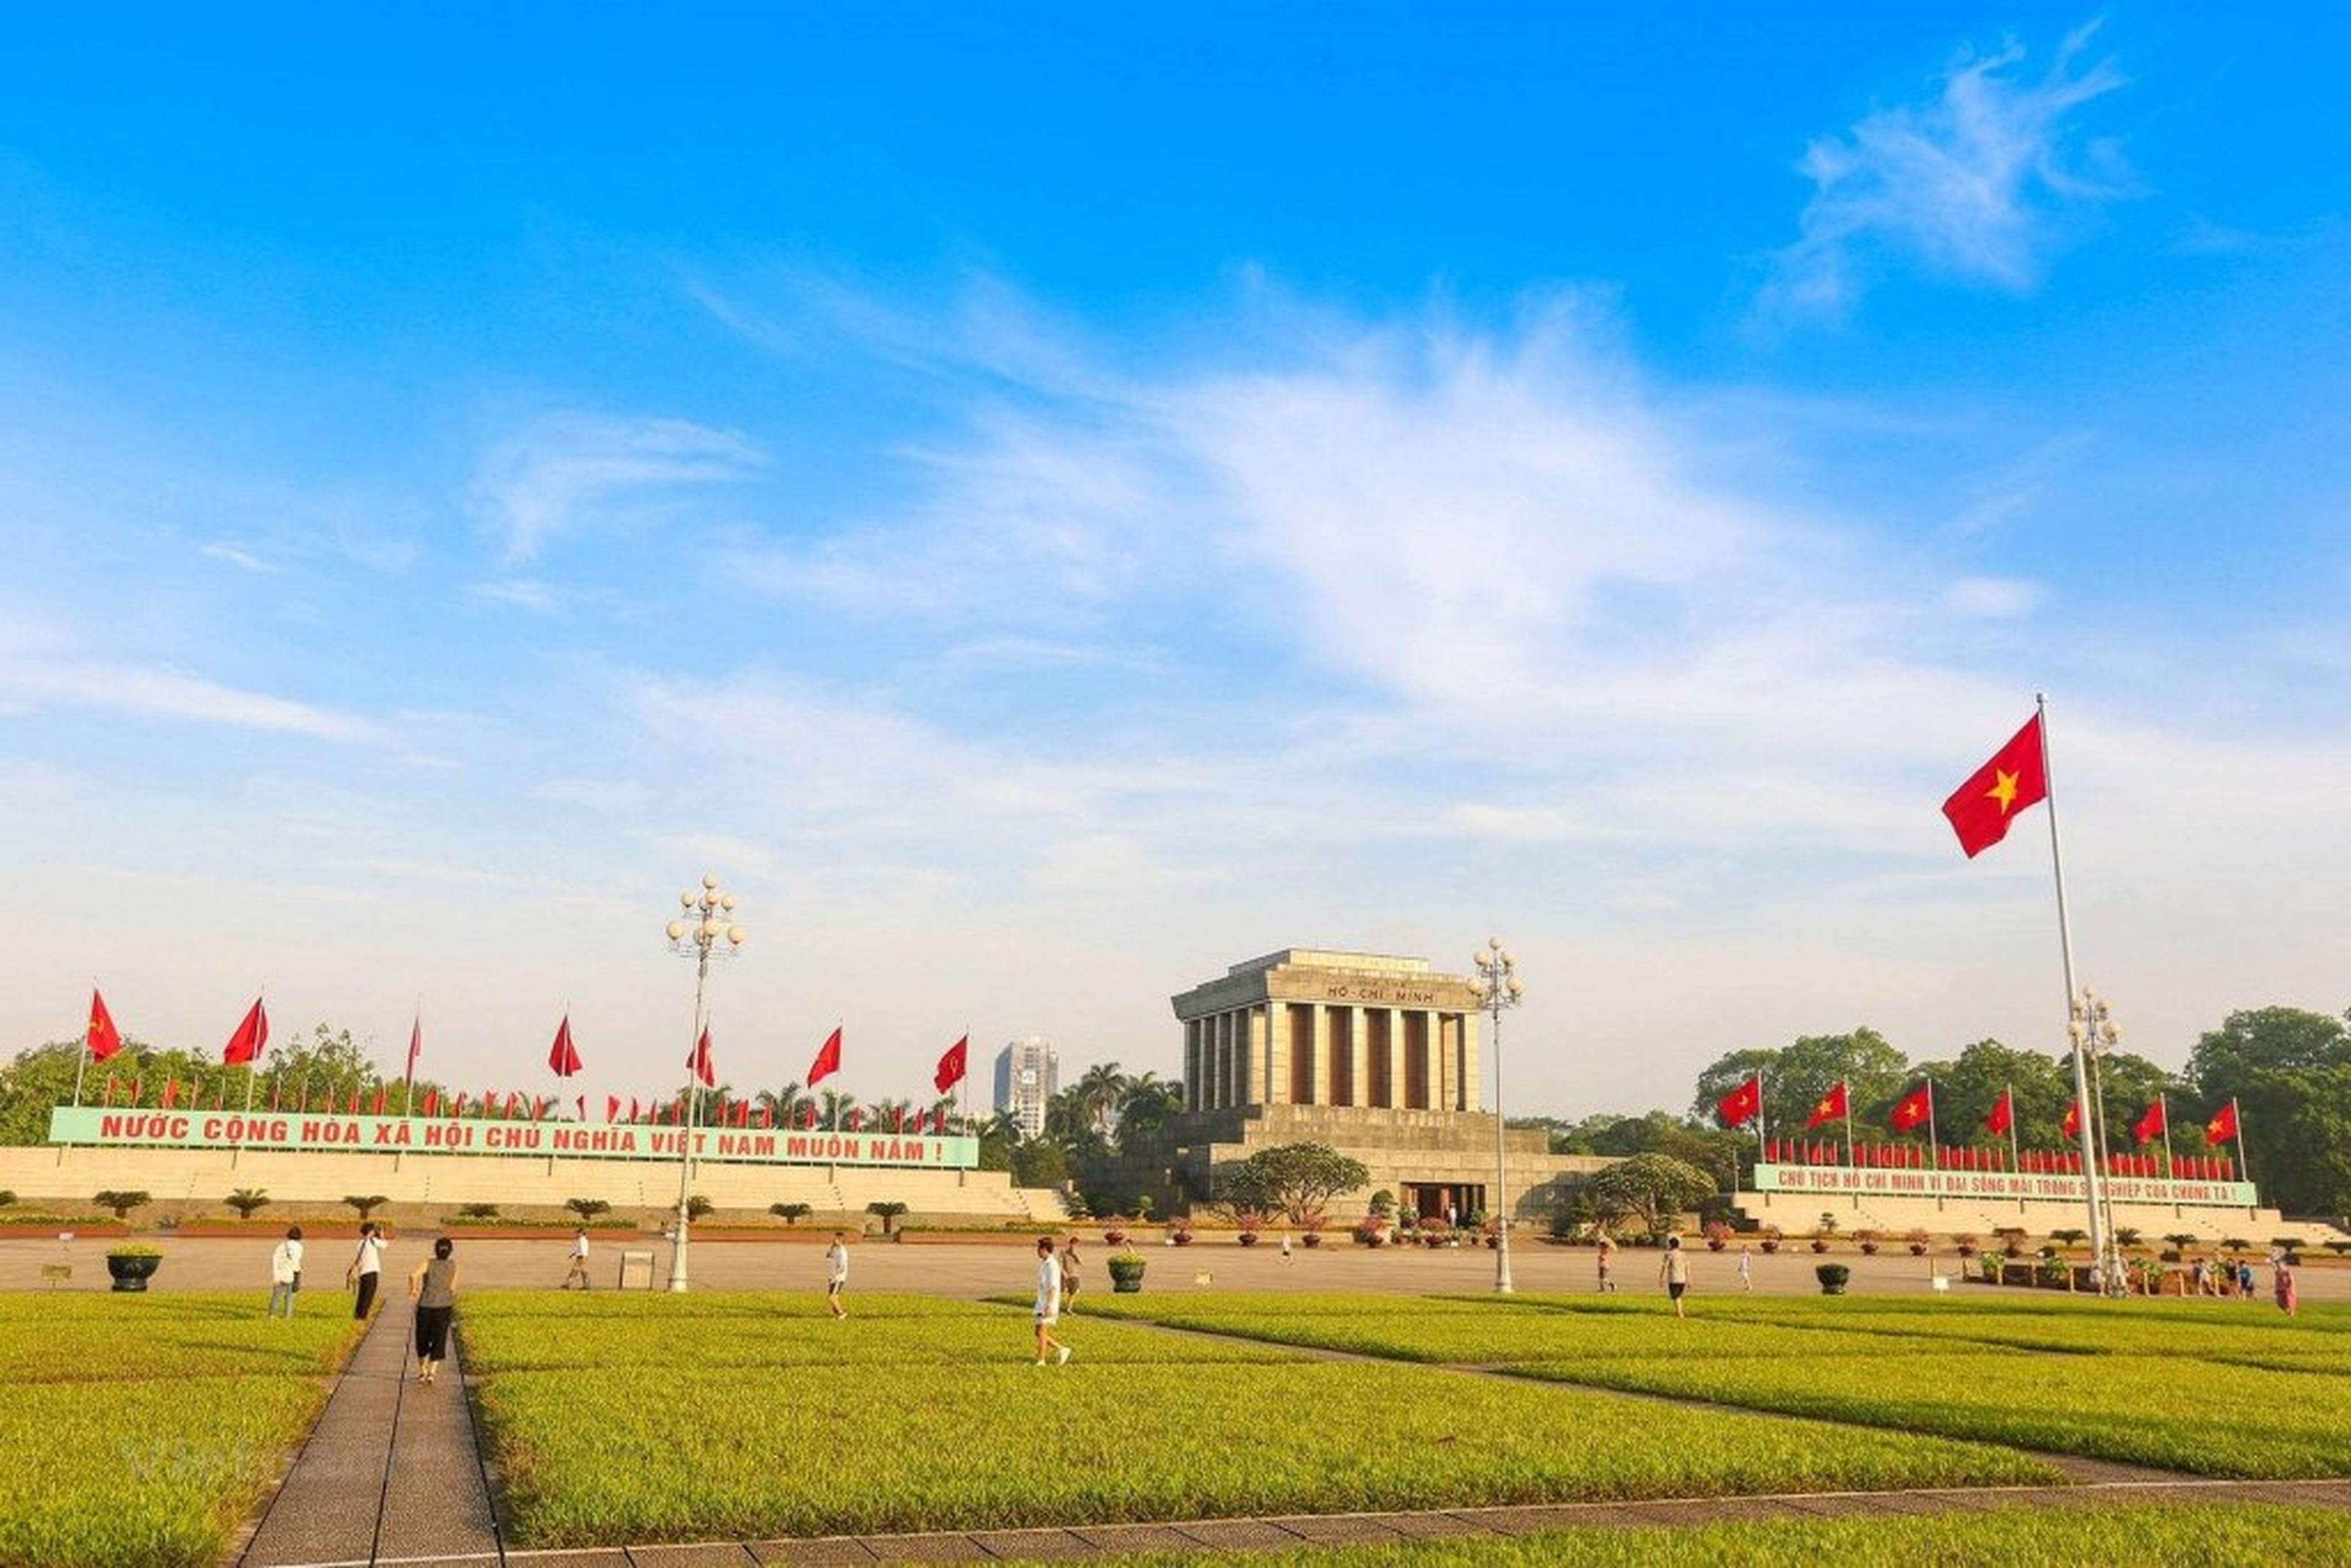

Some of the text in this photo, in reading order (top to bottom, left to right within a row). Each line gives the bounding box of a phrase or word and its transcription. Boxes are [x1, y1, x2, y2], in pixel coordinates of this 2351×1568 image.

[100, 1113, 189, 1139] NƯỚC
[203, 1115, 288, 1144] CỘNG
[301, 1117, 361, 1143] HÒA
[374, 1120, 411, 1144] XÃ
[425, 1122, 473, 1150] HỘI
[486, 1122, 541, 1148] CHỦ
[553, 1127, 636, 1150] NGHĨA
[718, 1135, 774, 1155] NAM
[787, 1135, 859, 1157] MUÔN
[936, 1142, 943, 1161] !
[1891, 1174, 1925, 1191] MINH
